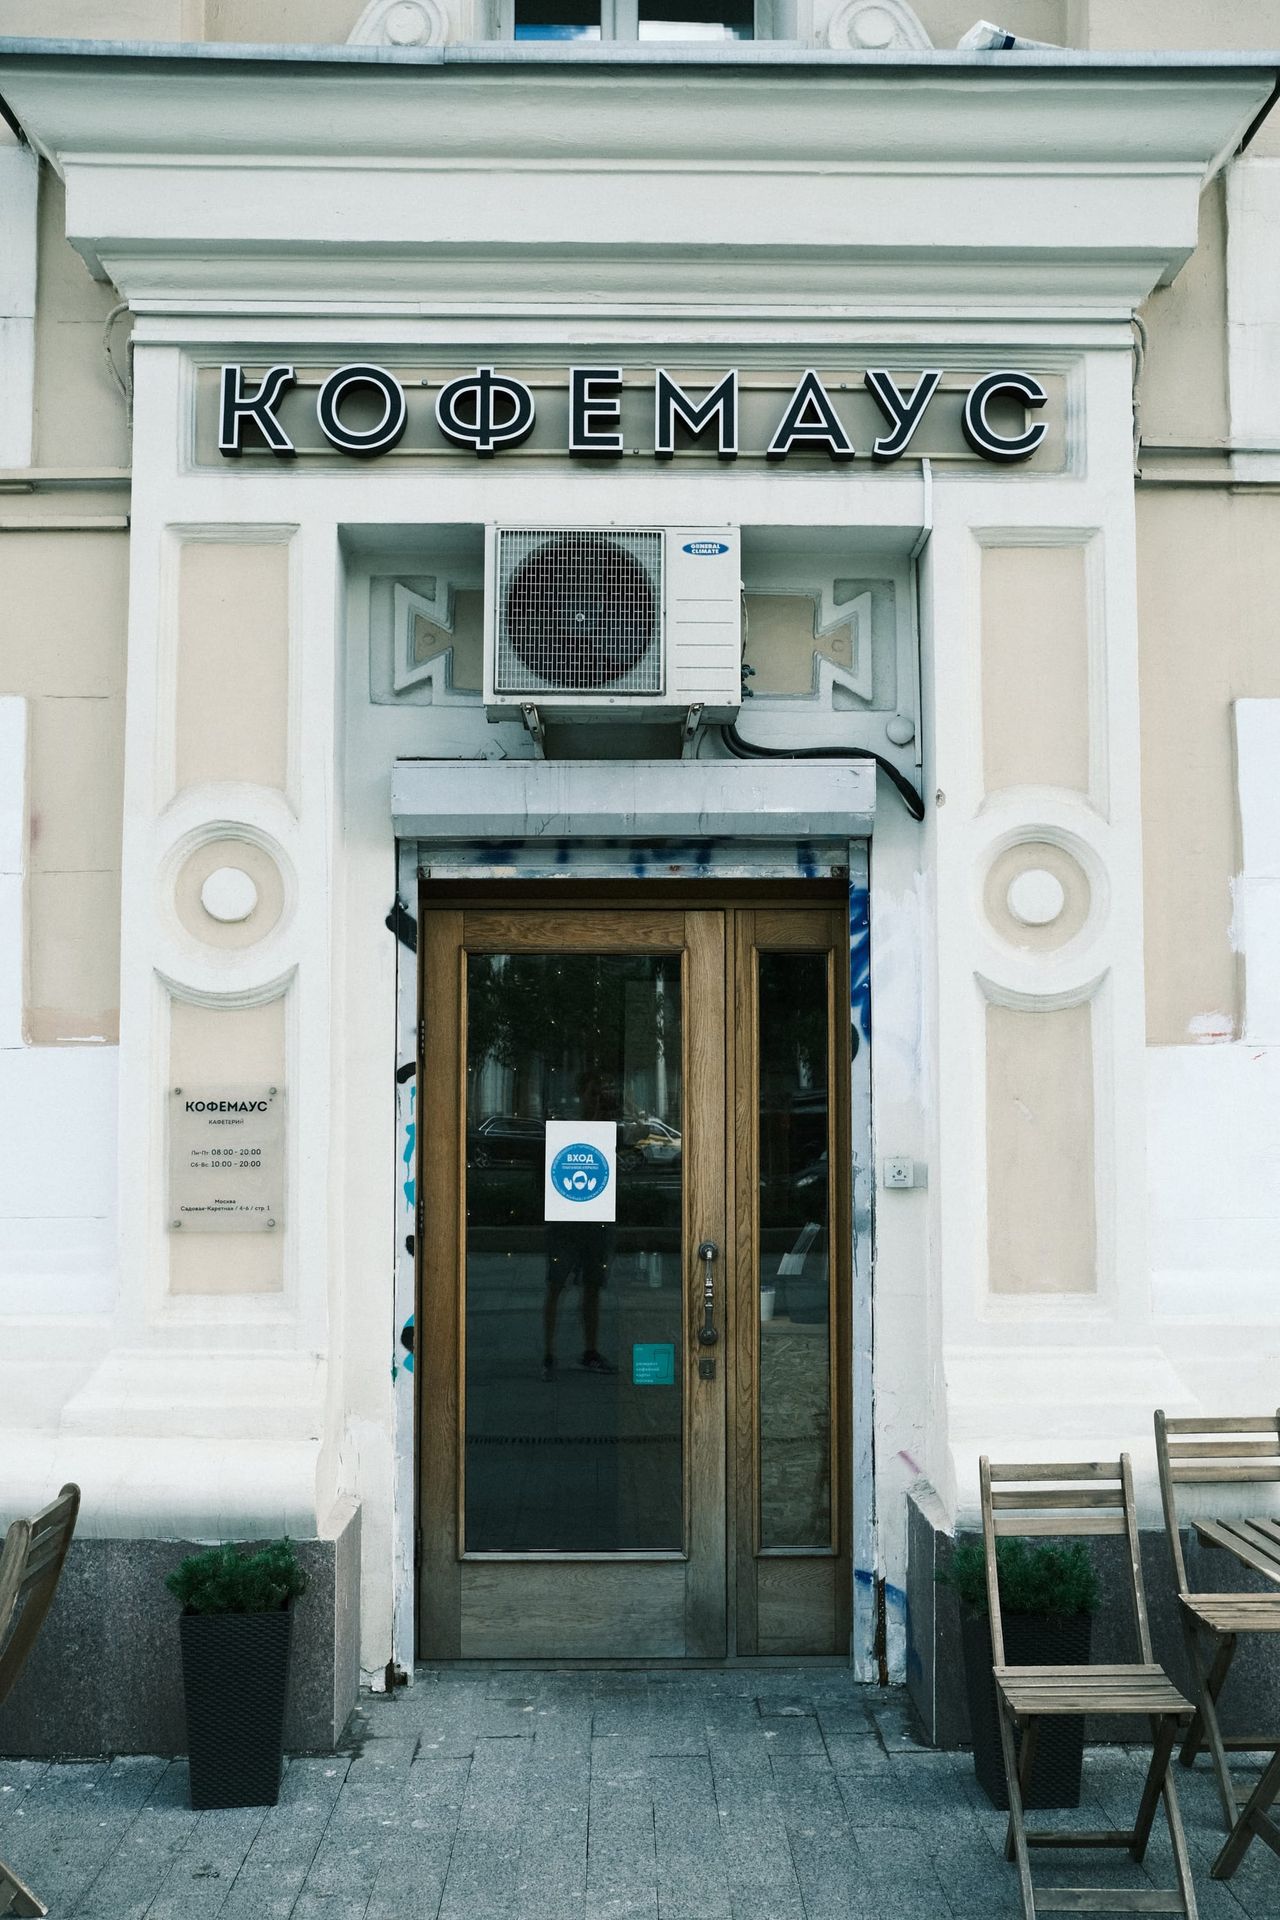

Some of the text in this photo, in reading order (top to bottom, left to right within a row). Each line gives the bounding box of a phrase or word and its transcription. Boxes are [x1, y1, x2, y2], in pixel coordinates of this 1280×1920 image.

[218, 363, 1050, 463] КОФЕМАУС
[185, 1101, 268, 1112] КОФЕМАУС
[239, 1160, 261, 1168] 20:00
[567, 1154, 594, 1164] ВХОД
